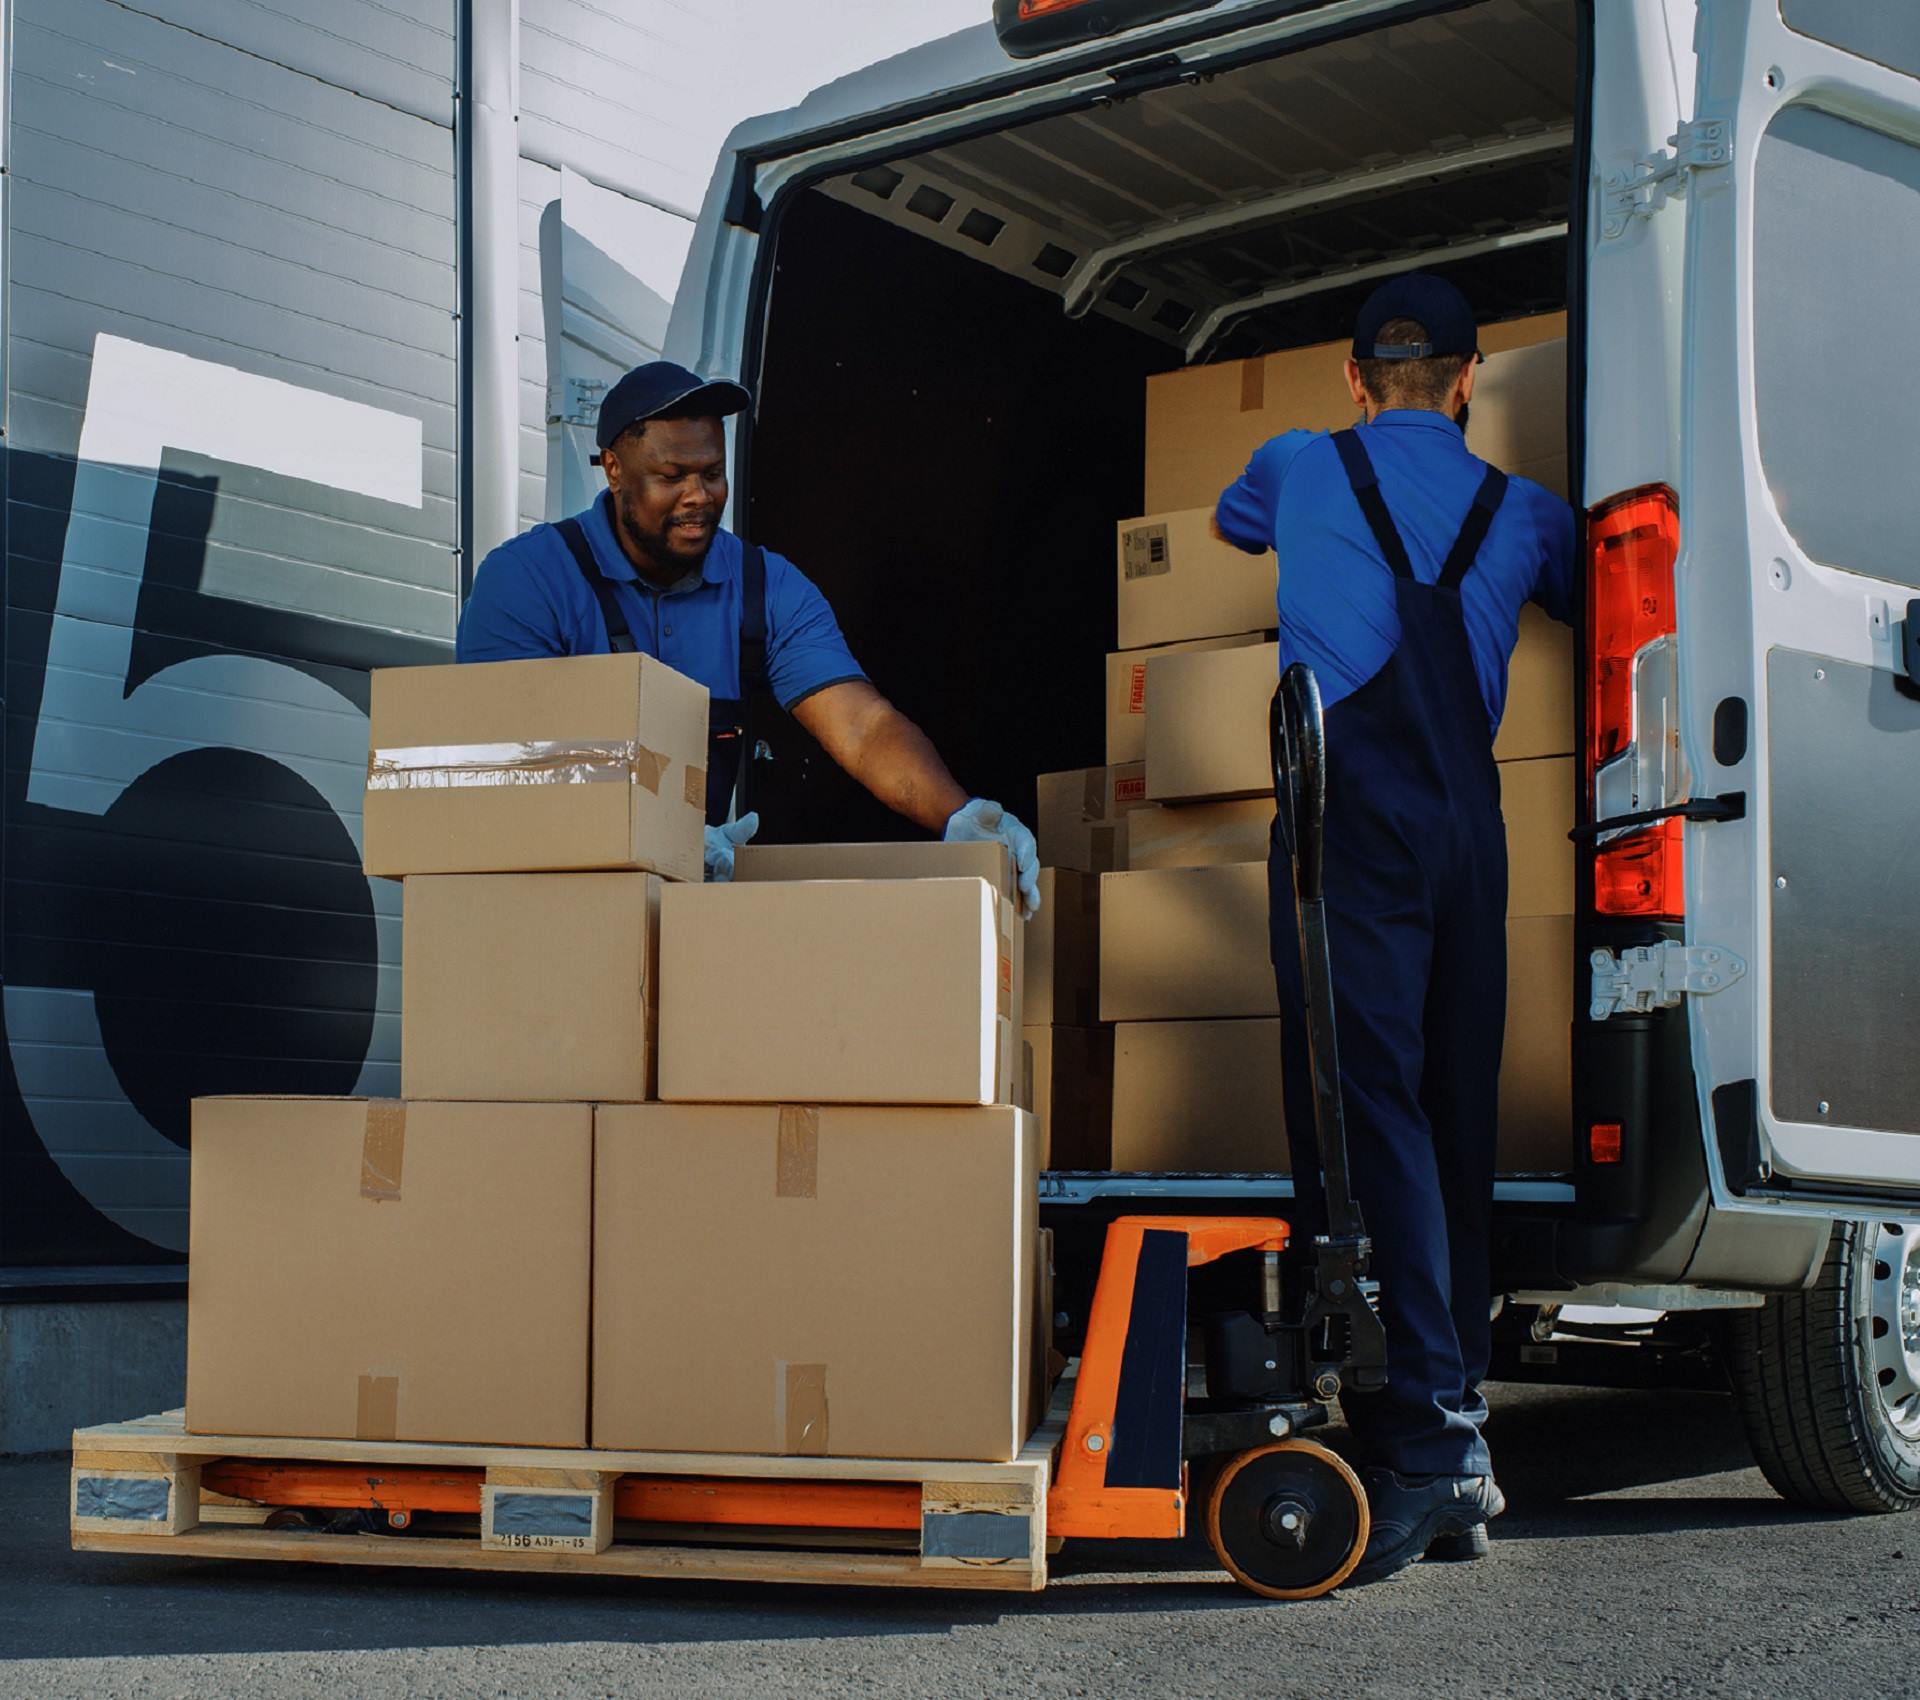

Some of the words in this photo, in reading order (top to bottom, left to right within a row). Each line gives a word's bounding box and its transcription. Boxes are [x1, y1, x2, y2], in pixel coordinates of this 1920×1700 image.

[1132, 667, 1145, 710] FRAGILE
[3, 332, 422, 1254] 5
[1118, 781, 1145, 796] FRAGI
